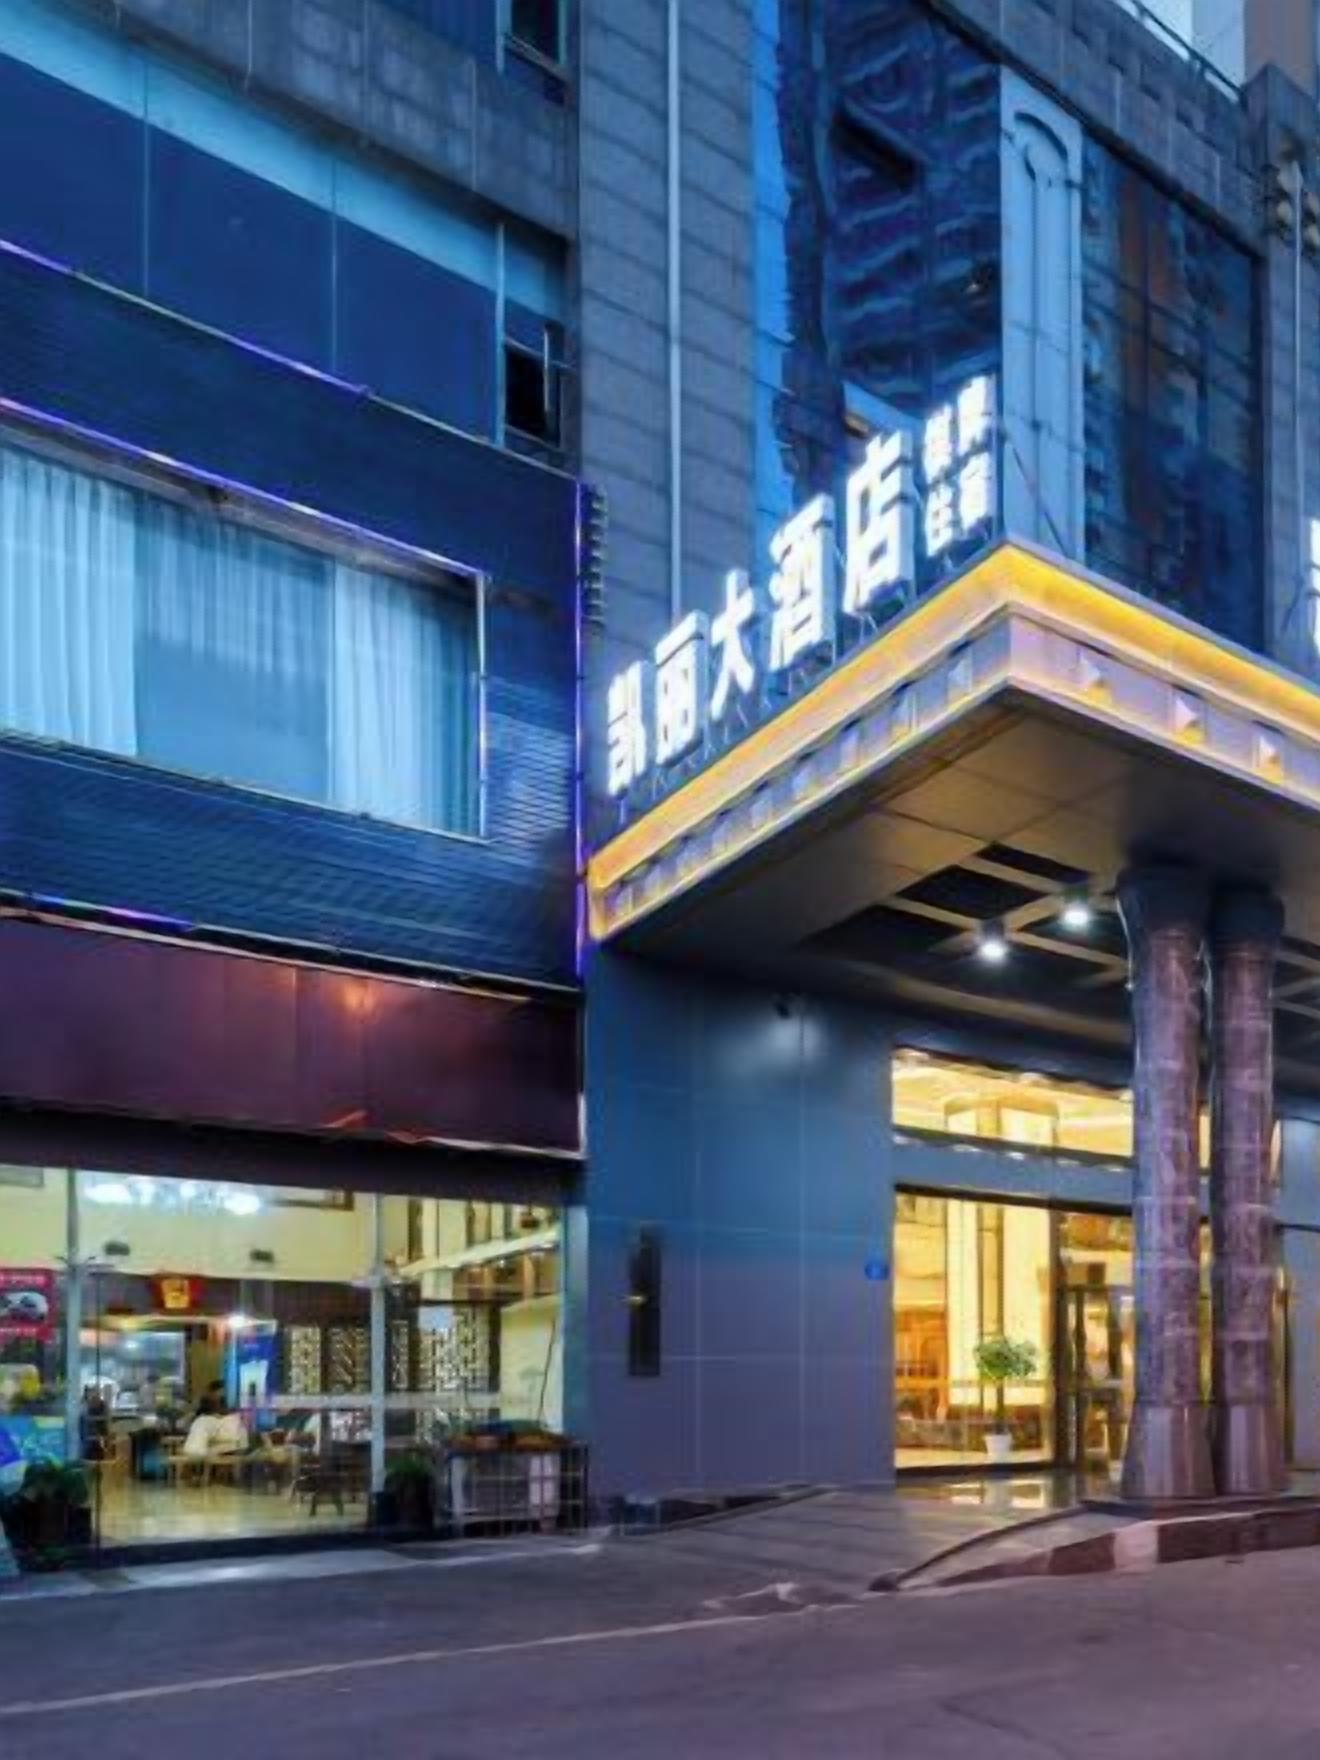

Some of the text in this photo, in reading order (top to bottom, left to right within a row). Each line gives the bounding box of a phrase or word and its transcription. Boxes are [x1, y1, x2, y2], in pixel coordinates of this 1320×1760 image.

[607, 430, 914, 796] 凯丽大酒店
